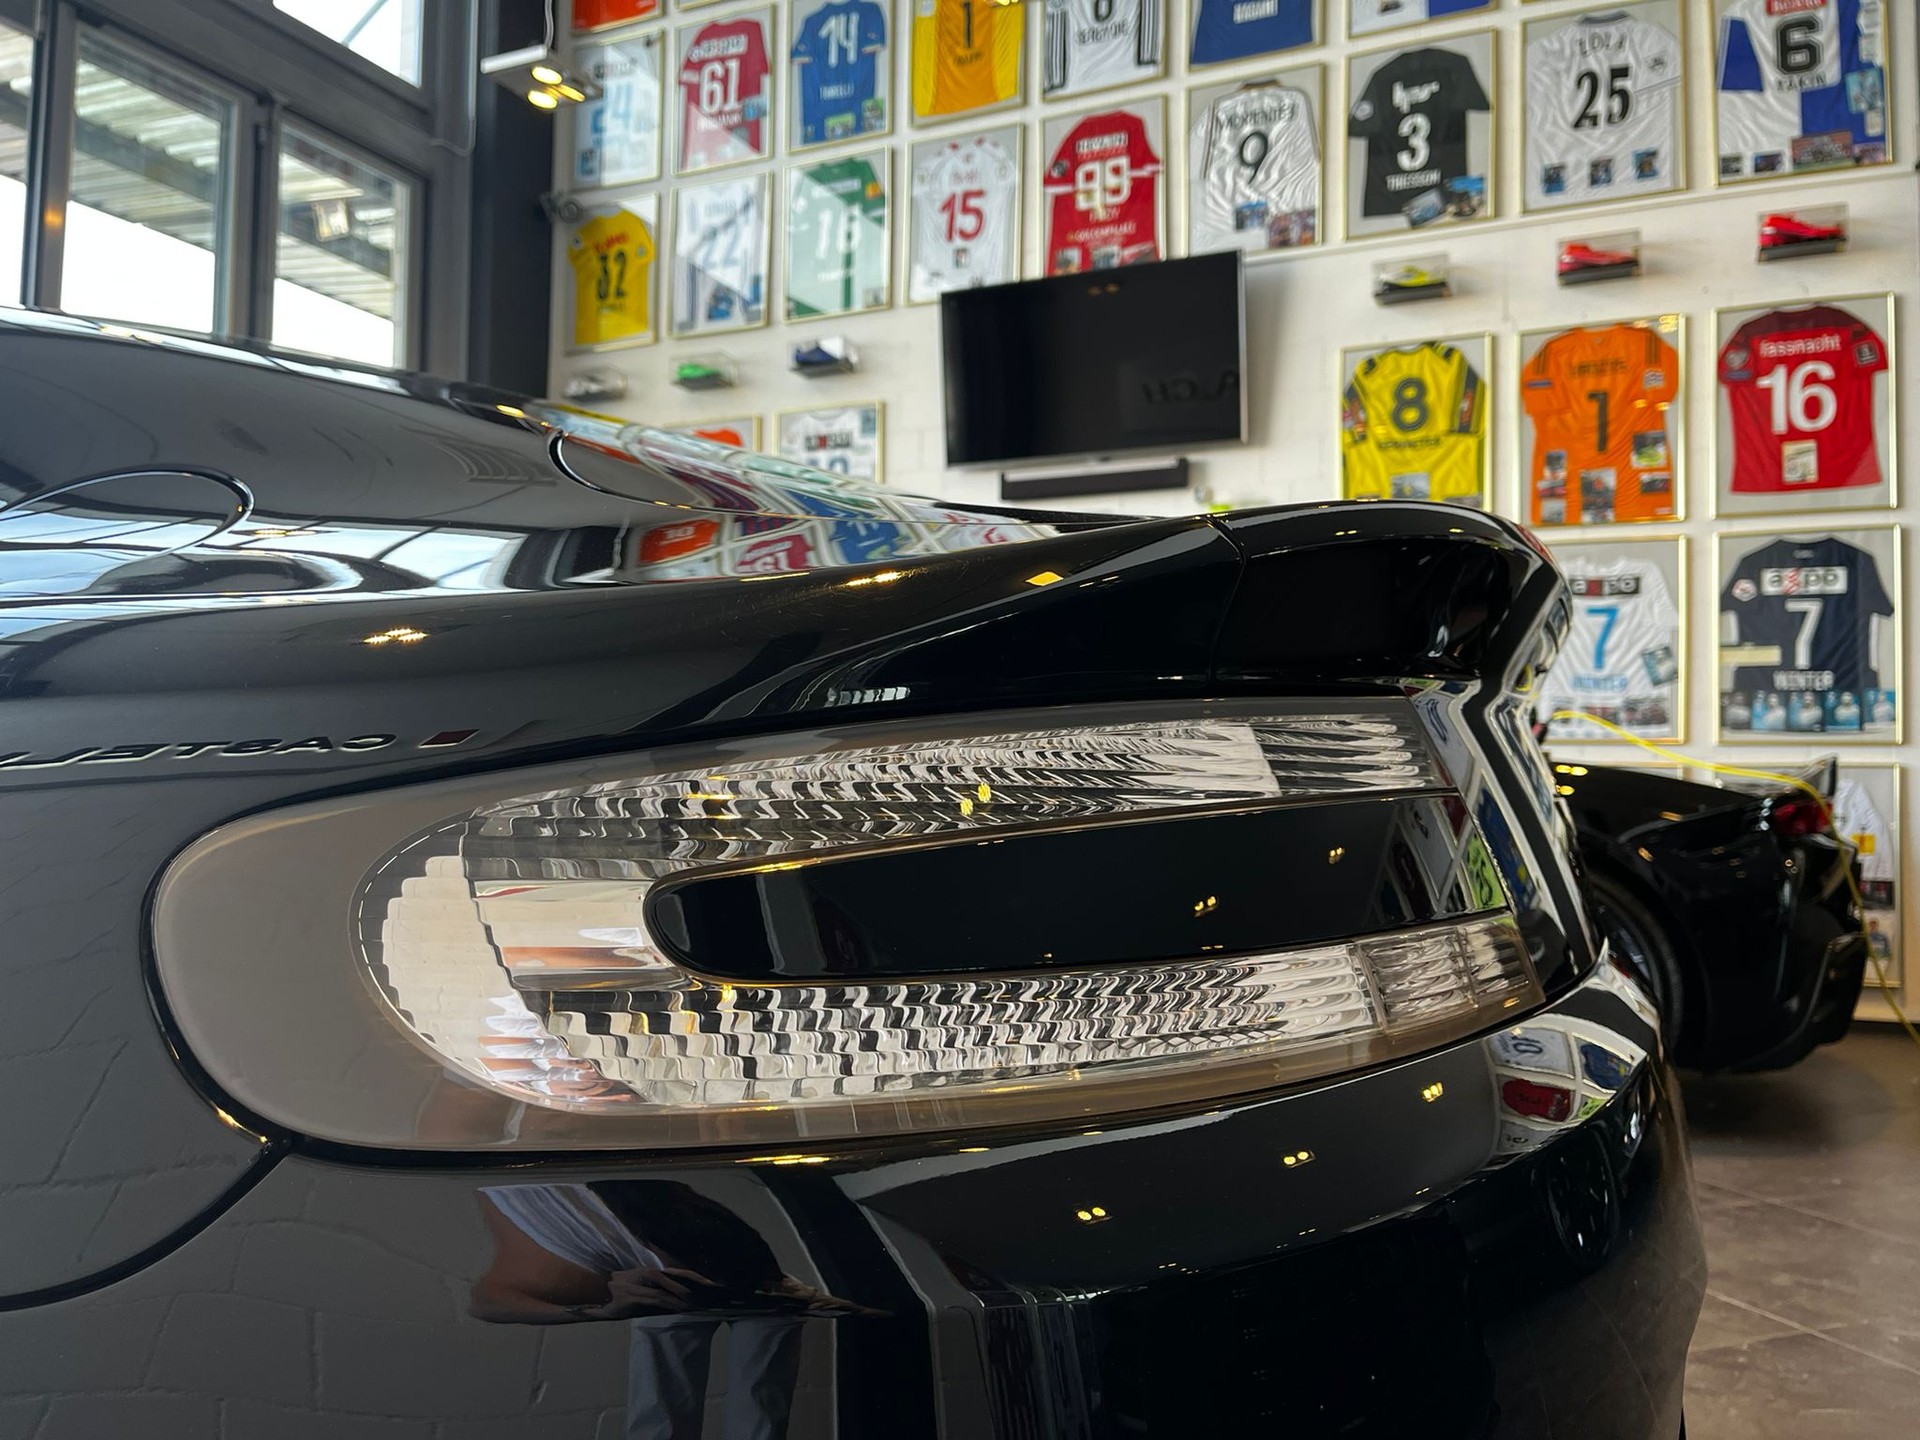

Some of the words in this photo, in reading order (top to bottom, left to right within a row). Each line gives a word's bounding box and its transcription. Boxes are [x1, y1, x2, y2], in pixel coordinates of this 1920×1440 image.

[818, 11, 860, 68] 14
[1775, 12, 1825, 76] 6
[700, 58, 740, 114] 61
[1573, 66, 1630, 129] 25
[1239, 130, 1269, 185] 9
[1397, 113, 1431, 172] 3
[1075, 155, 1131, 212] 99
[939, 189, 985, 243] 15
[1392, 377, 1428, 432] 8
[1587, 391, 1608, 453] 1
[1756, 360, 1838, 435] 16
[1586, 606, 1618, 669] 7
[1784, 598, 1822, 669] 7
[1773, 670, 1834, 690] WINTER
